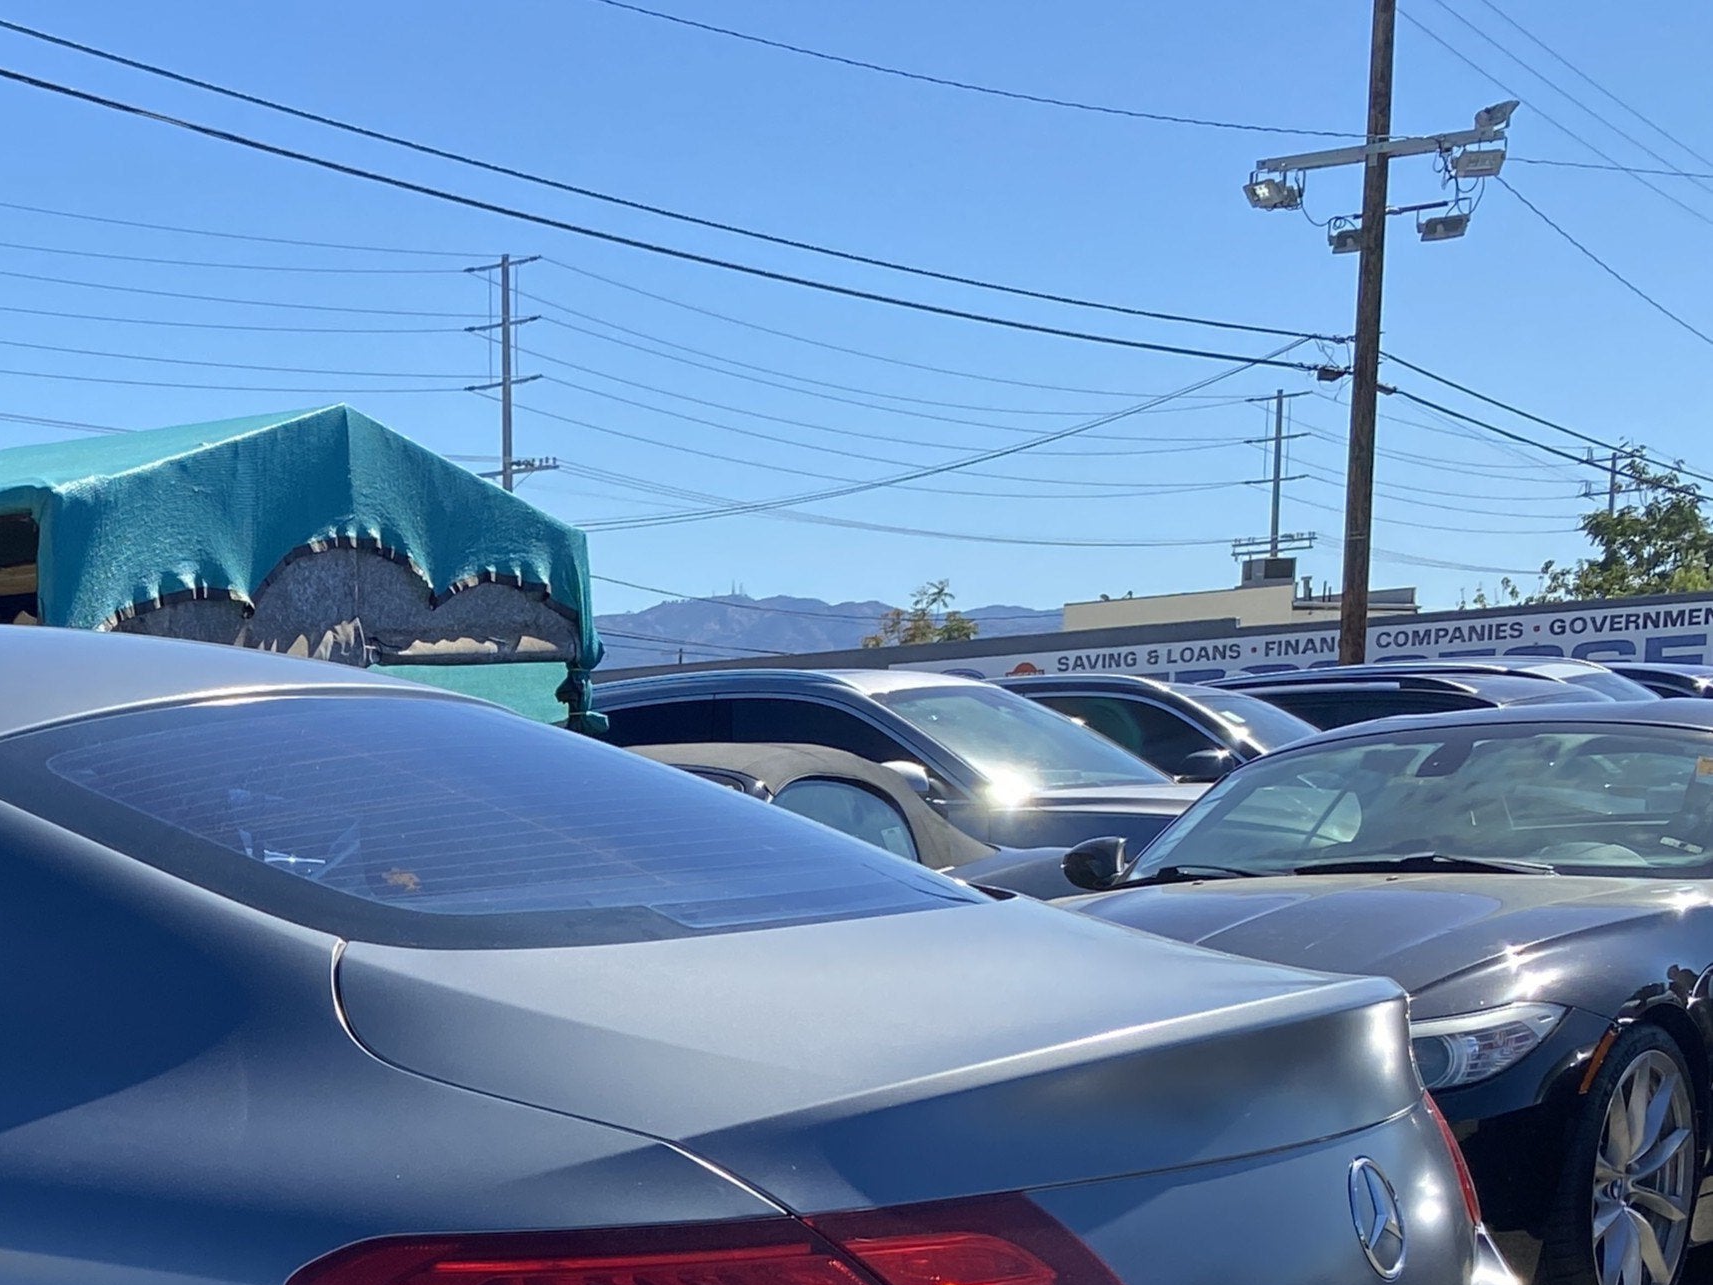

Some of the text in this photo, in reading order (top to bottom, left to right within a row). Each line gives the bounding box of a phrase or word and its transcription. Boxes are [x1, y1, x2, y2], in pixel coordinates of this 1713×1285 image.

[1056, 651, 1137, 673] SAVING
[1146, 649, 1160, 665] &
[1166, 642, 1242, 665] LOANS
[1263, 636, 1341, 658] FINAN
[1375, 621, 1524, 649] COMPANIES
